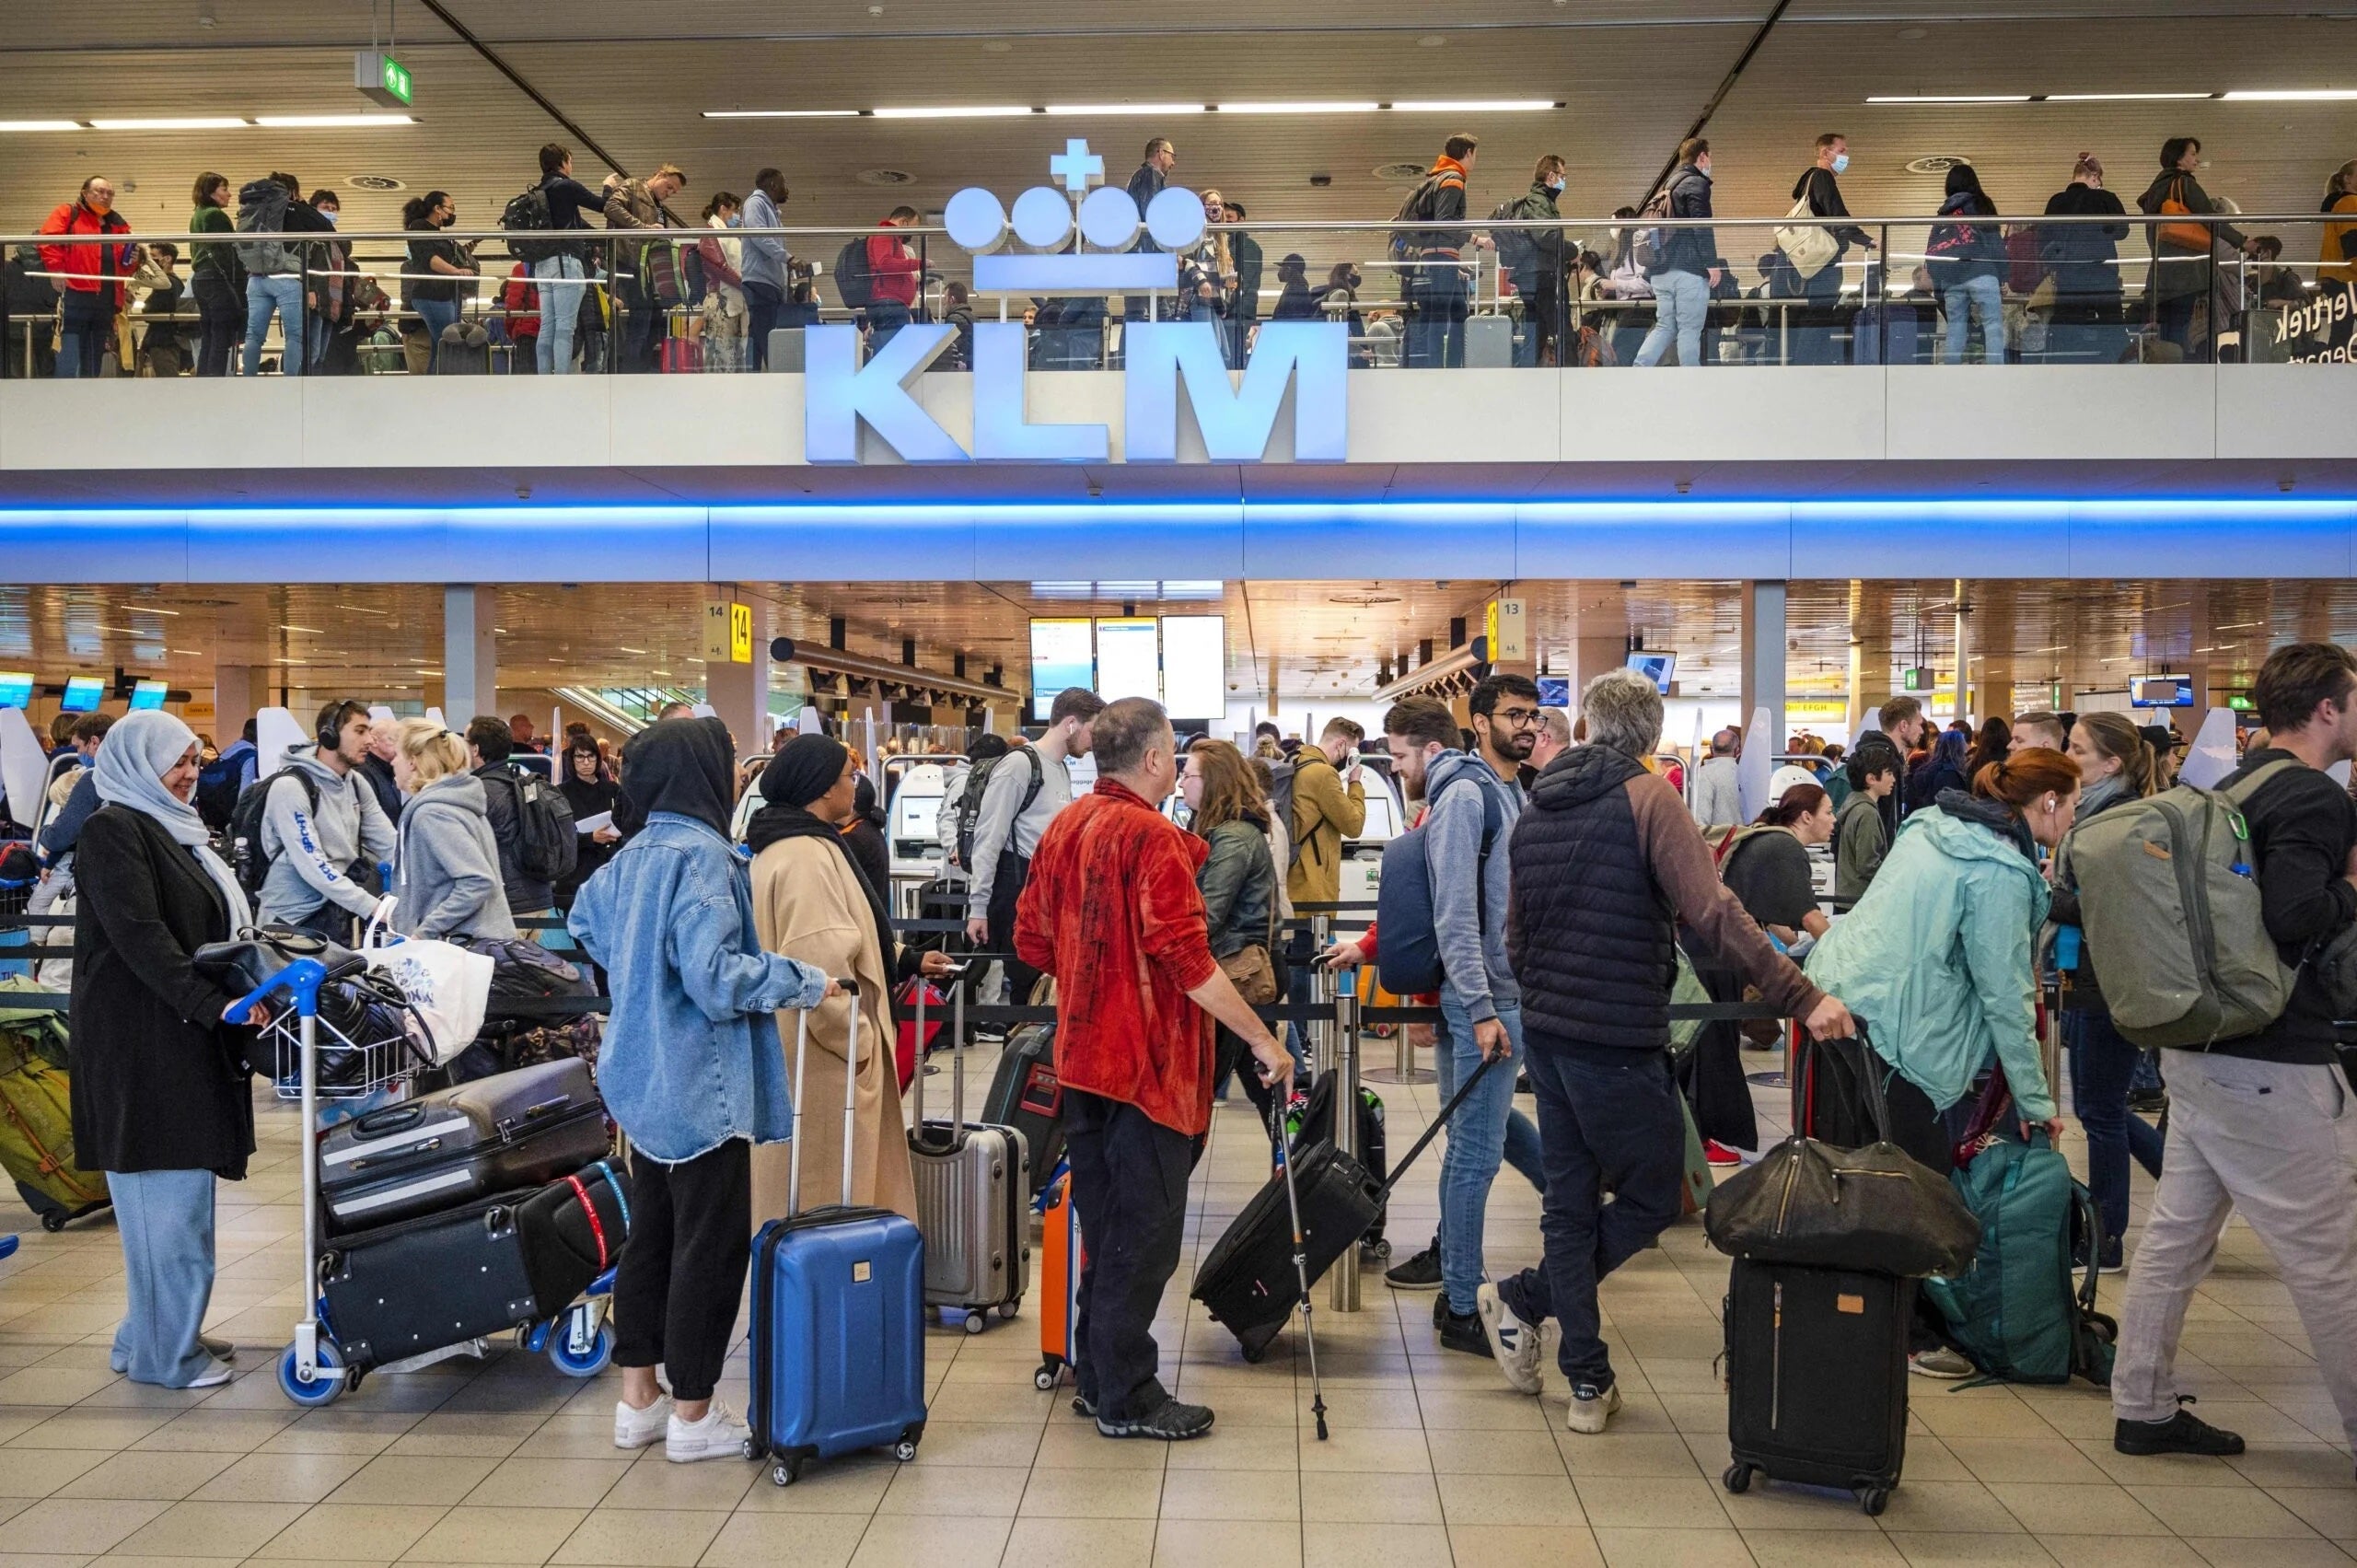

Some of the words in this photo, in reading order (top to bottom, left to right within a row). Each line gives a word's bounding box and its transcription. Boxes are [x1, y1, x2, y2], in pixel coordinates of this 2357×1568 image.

[806, 322, 1349, 464] KLM
[709, 606, 724, 617] 14
[1504, 603, 1519, 615] 13
[734, 609, 748, 645] 14
[316, 857, 338, 881] POL
